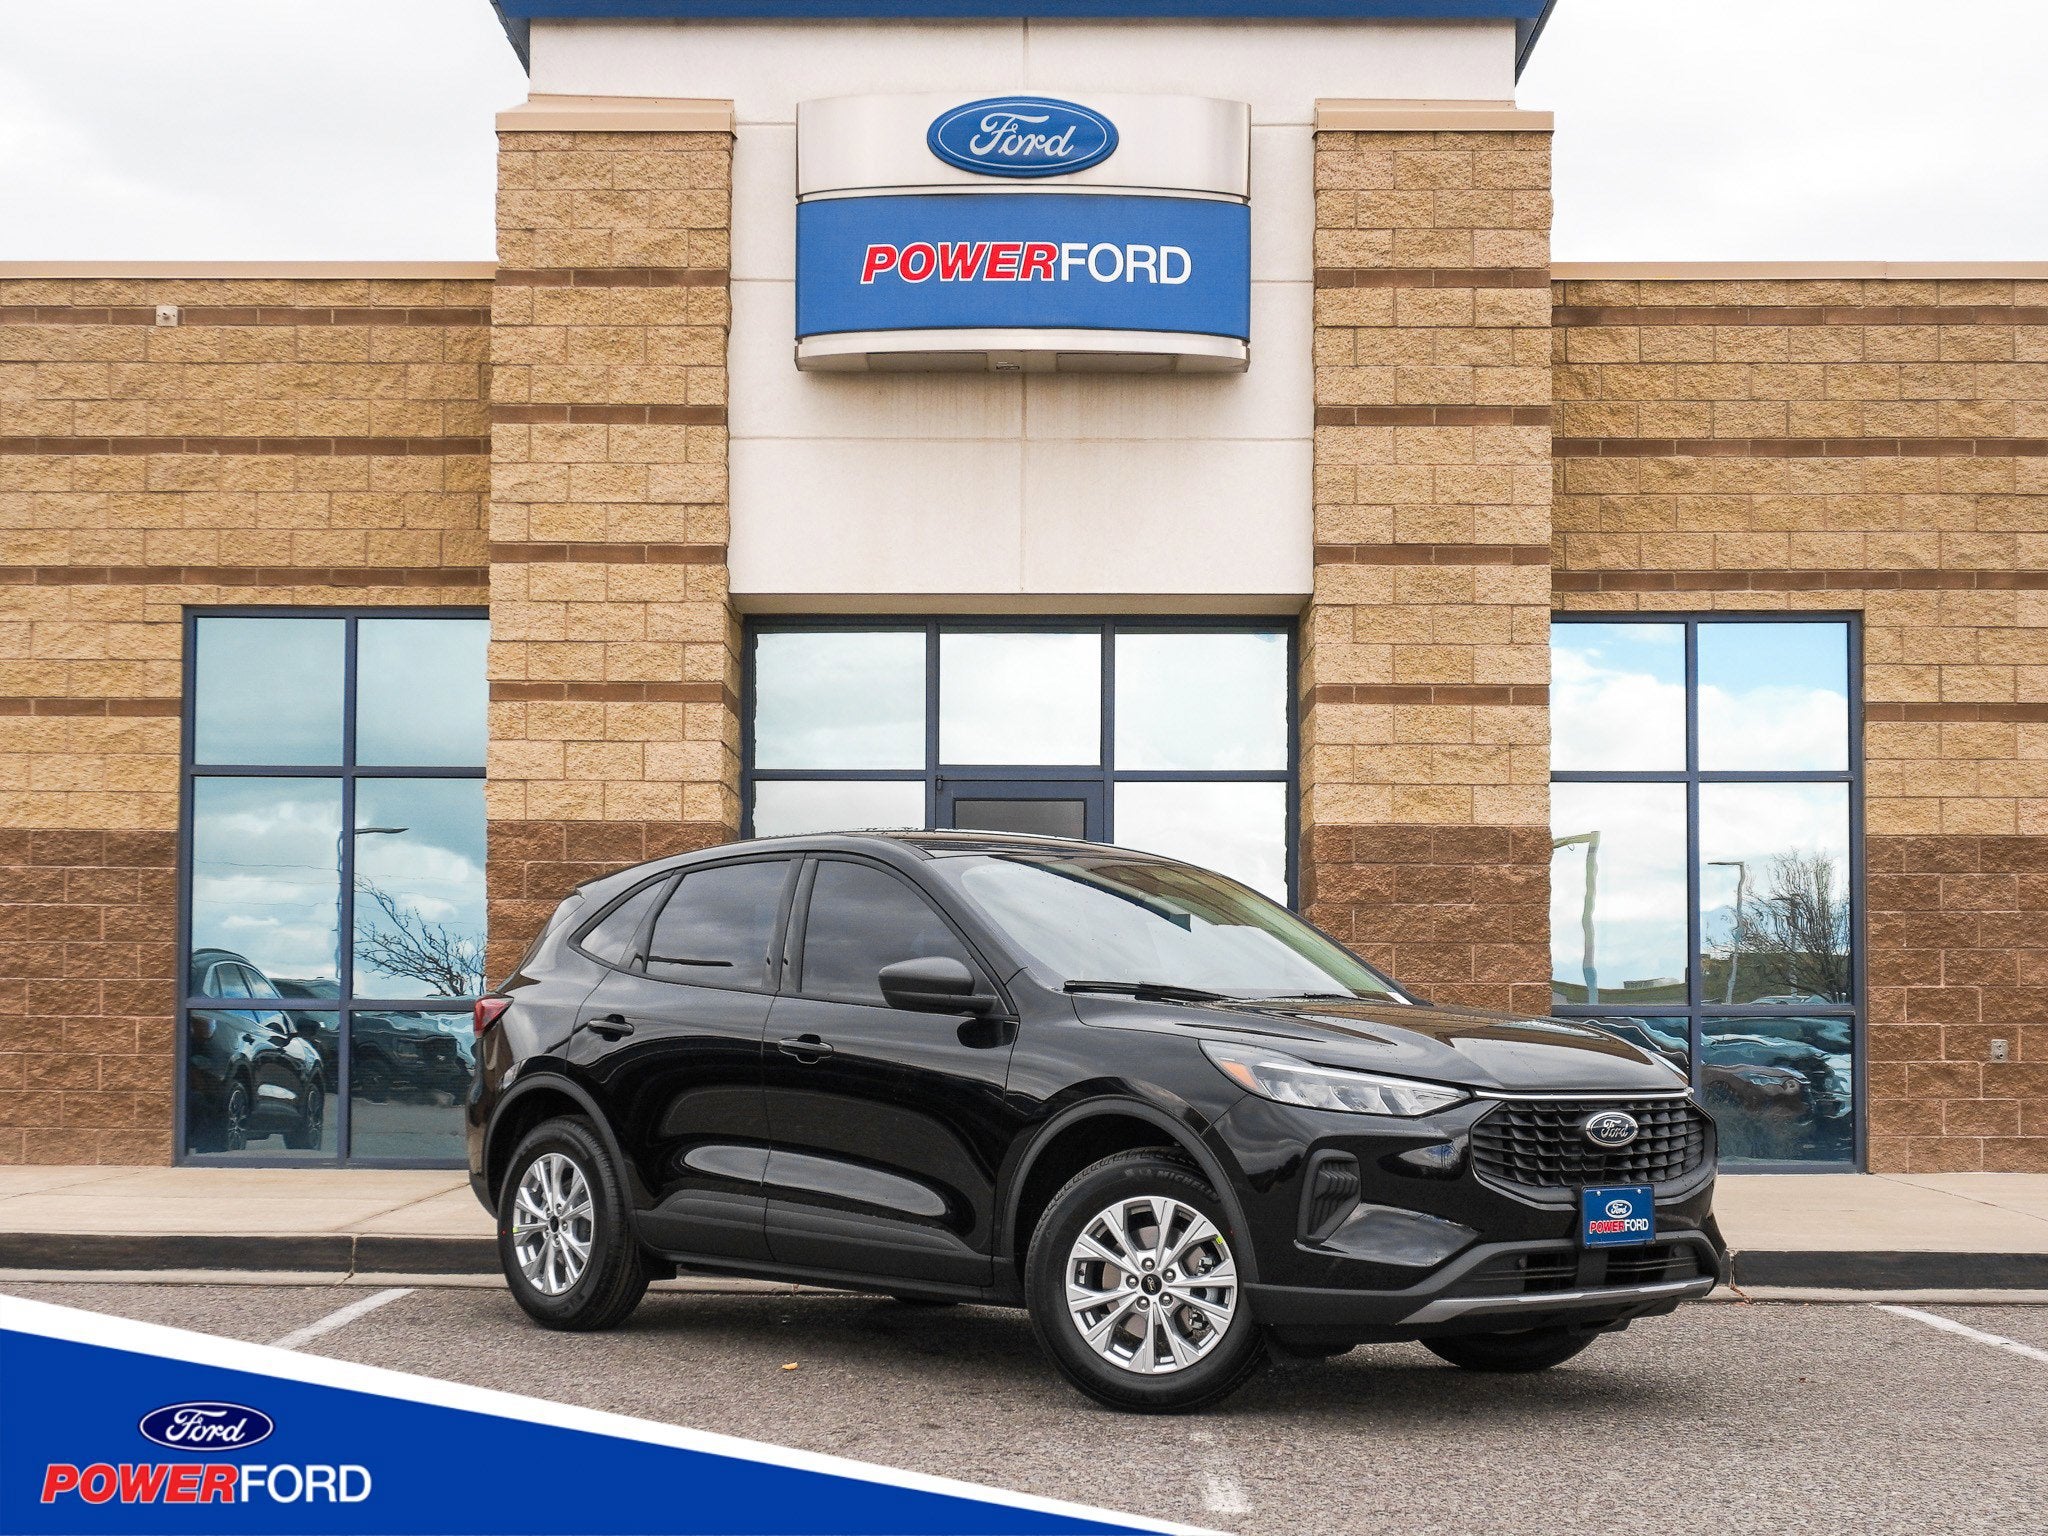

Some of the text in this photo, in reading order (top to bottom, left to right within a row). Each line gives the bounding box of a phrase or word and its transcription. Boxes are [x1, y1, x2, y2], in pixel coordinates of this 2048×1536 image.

[969, 111, 1076, 158] Ford
[1601, 1119, 1629, 1138] Ford
[1611, 1203, 1627, 1214] Ford
